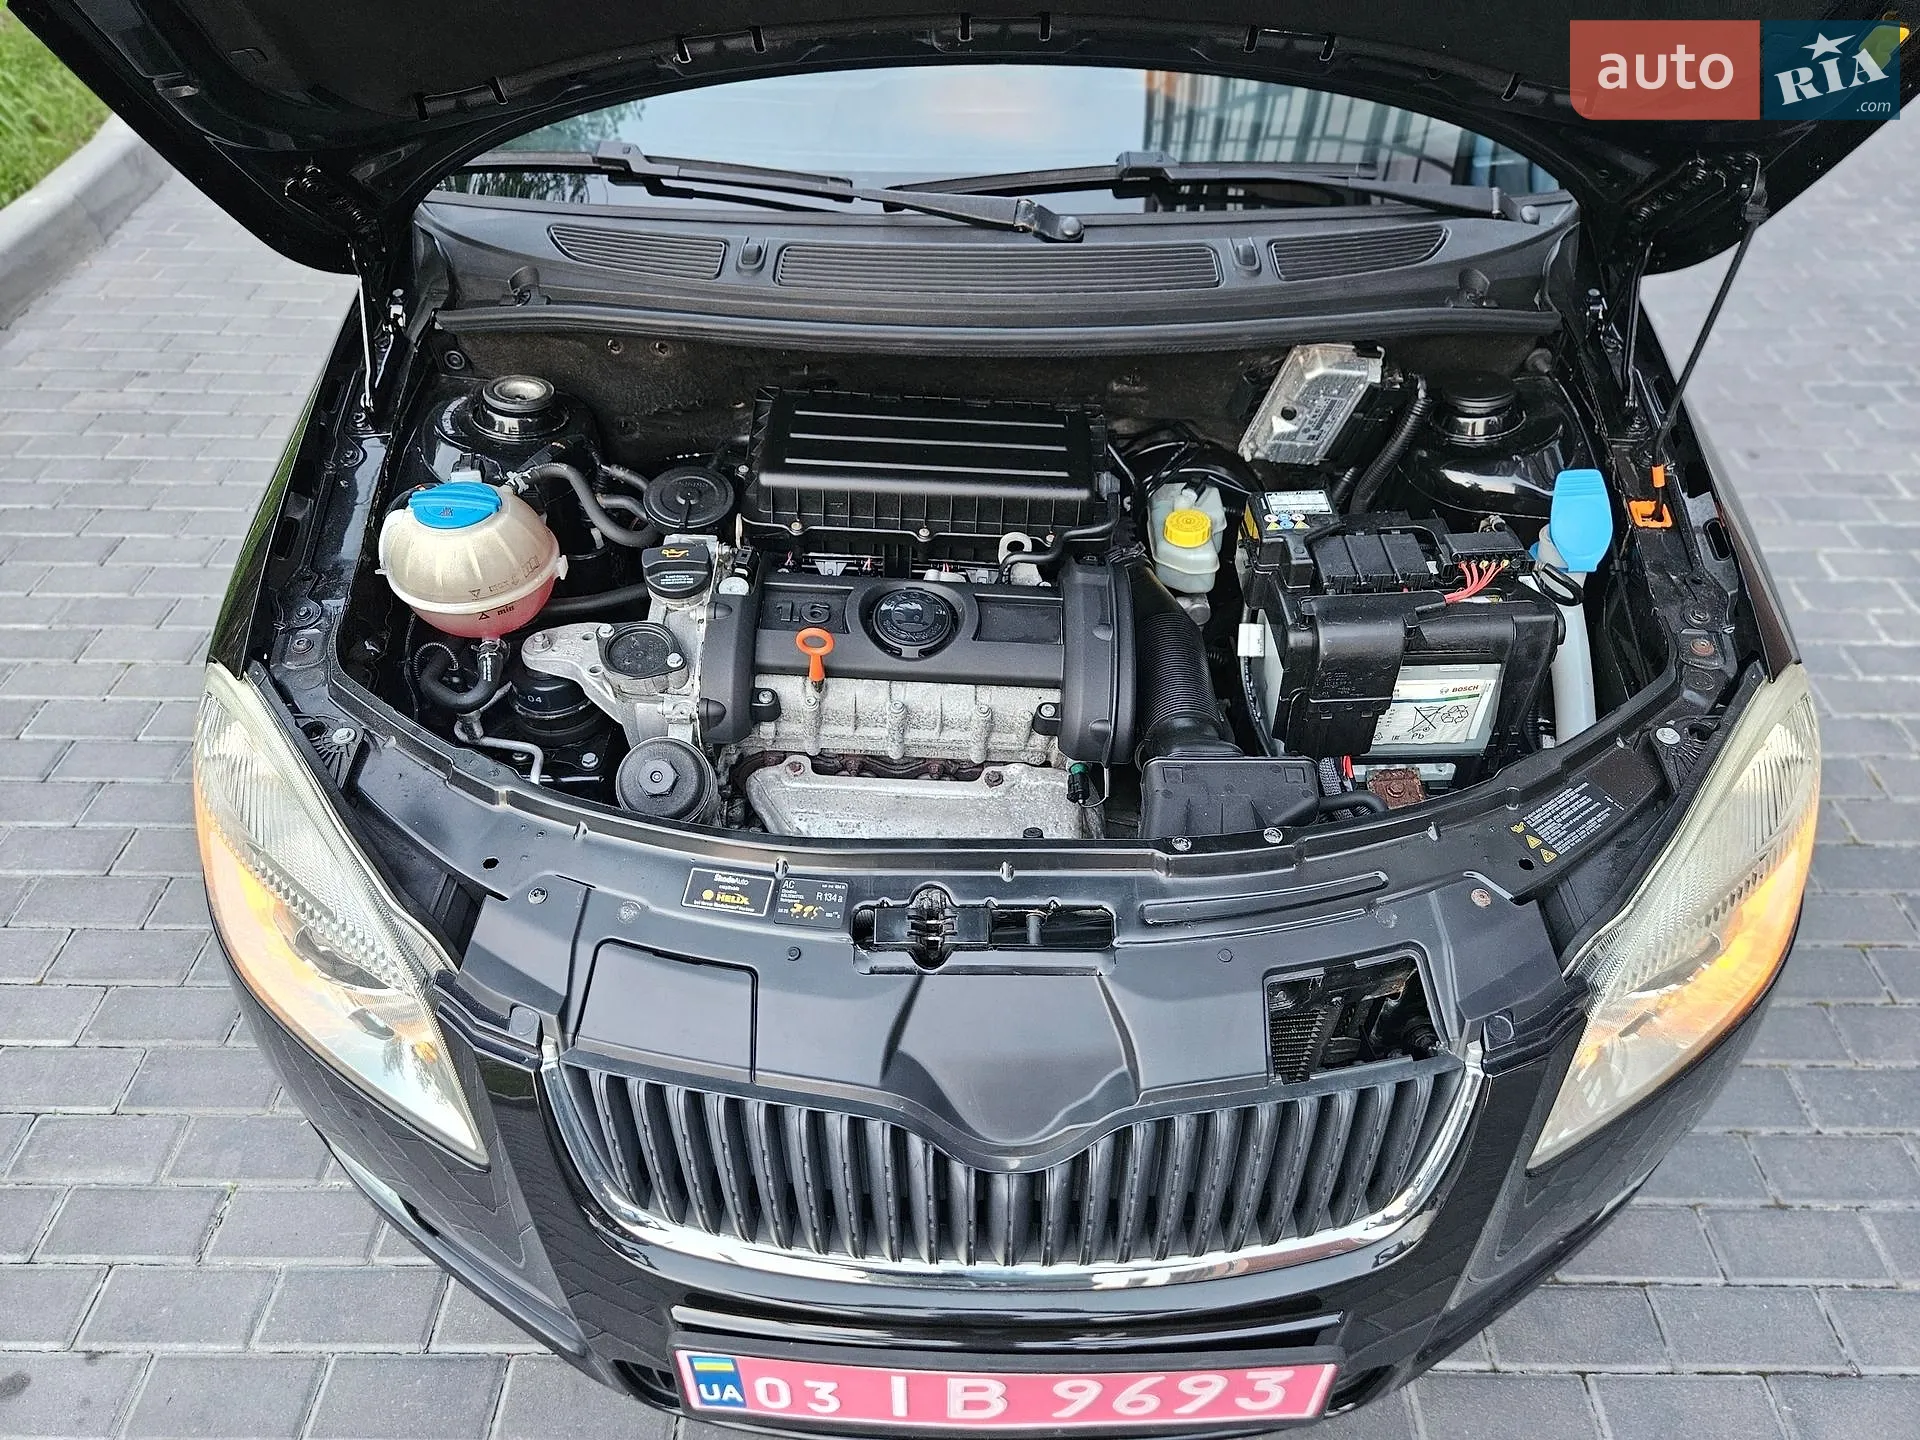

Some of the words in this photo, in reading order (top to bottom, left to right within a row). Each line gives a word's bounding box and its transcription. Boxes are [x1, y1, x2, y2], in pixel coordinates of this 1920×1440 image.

[497, 605, 515, 615] min
[776, 600, 831, 624] 1.6
[1451, 684, 1480, 693] BOSCH
[782, 880, 795, 889] AC
[699, 1383, 744, 1401] UA
[754, 1376, 841, 1413] 03
[1052, 1370, 1295, 1418] 9693
